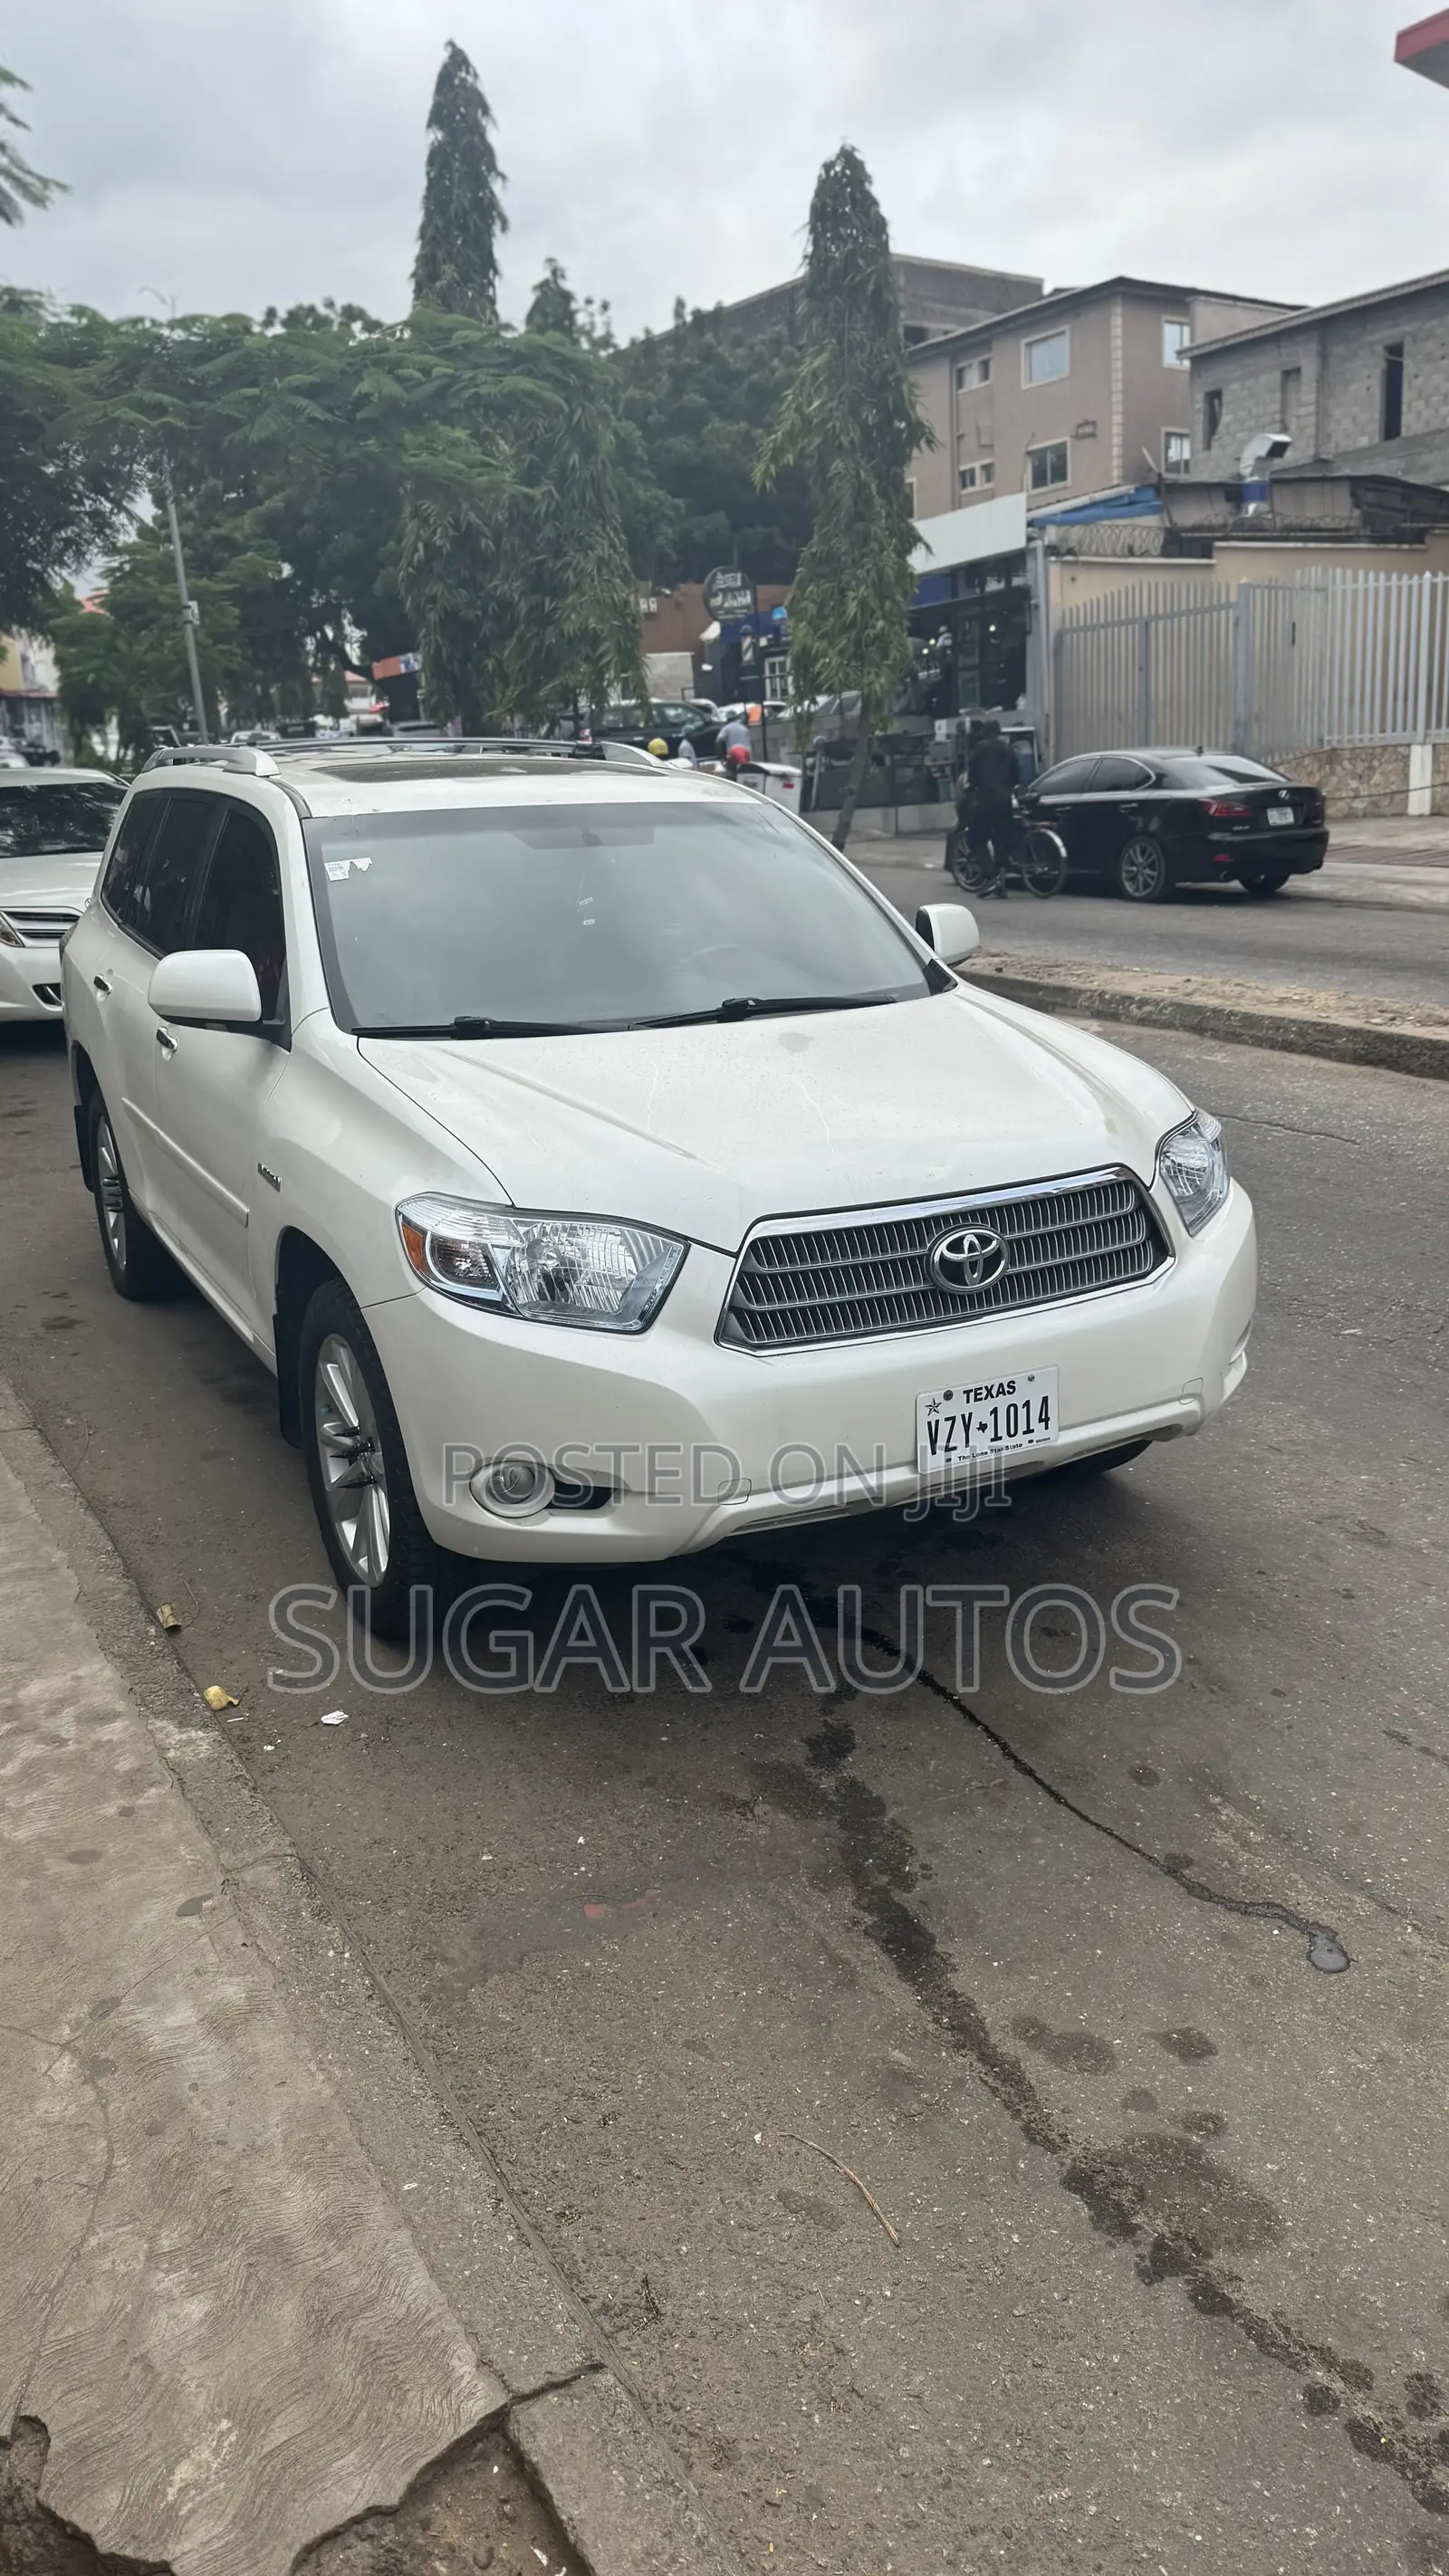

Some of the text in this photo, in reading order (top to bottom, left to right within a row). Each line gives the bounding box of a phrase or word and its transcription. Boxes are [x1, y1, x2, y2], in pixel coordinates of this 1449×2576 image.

[963, 1380, 1016, 1404] TEXAS
[926, 1395, 1051, 1456] VZY 1014
[972, 1451, 988, 1459] Lone
[990, 1447, 1003, 1455] Star
[1005, 1442, 1023, 1451] State
